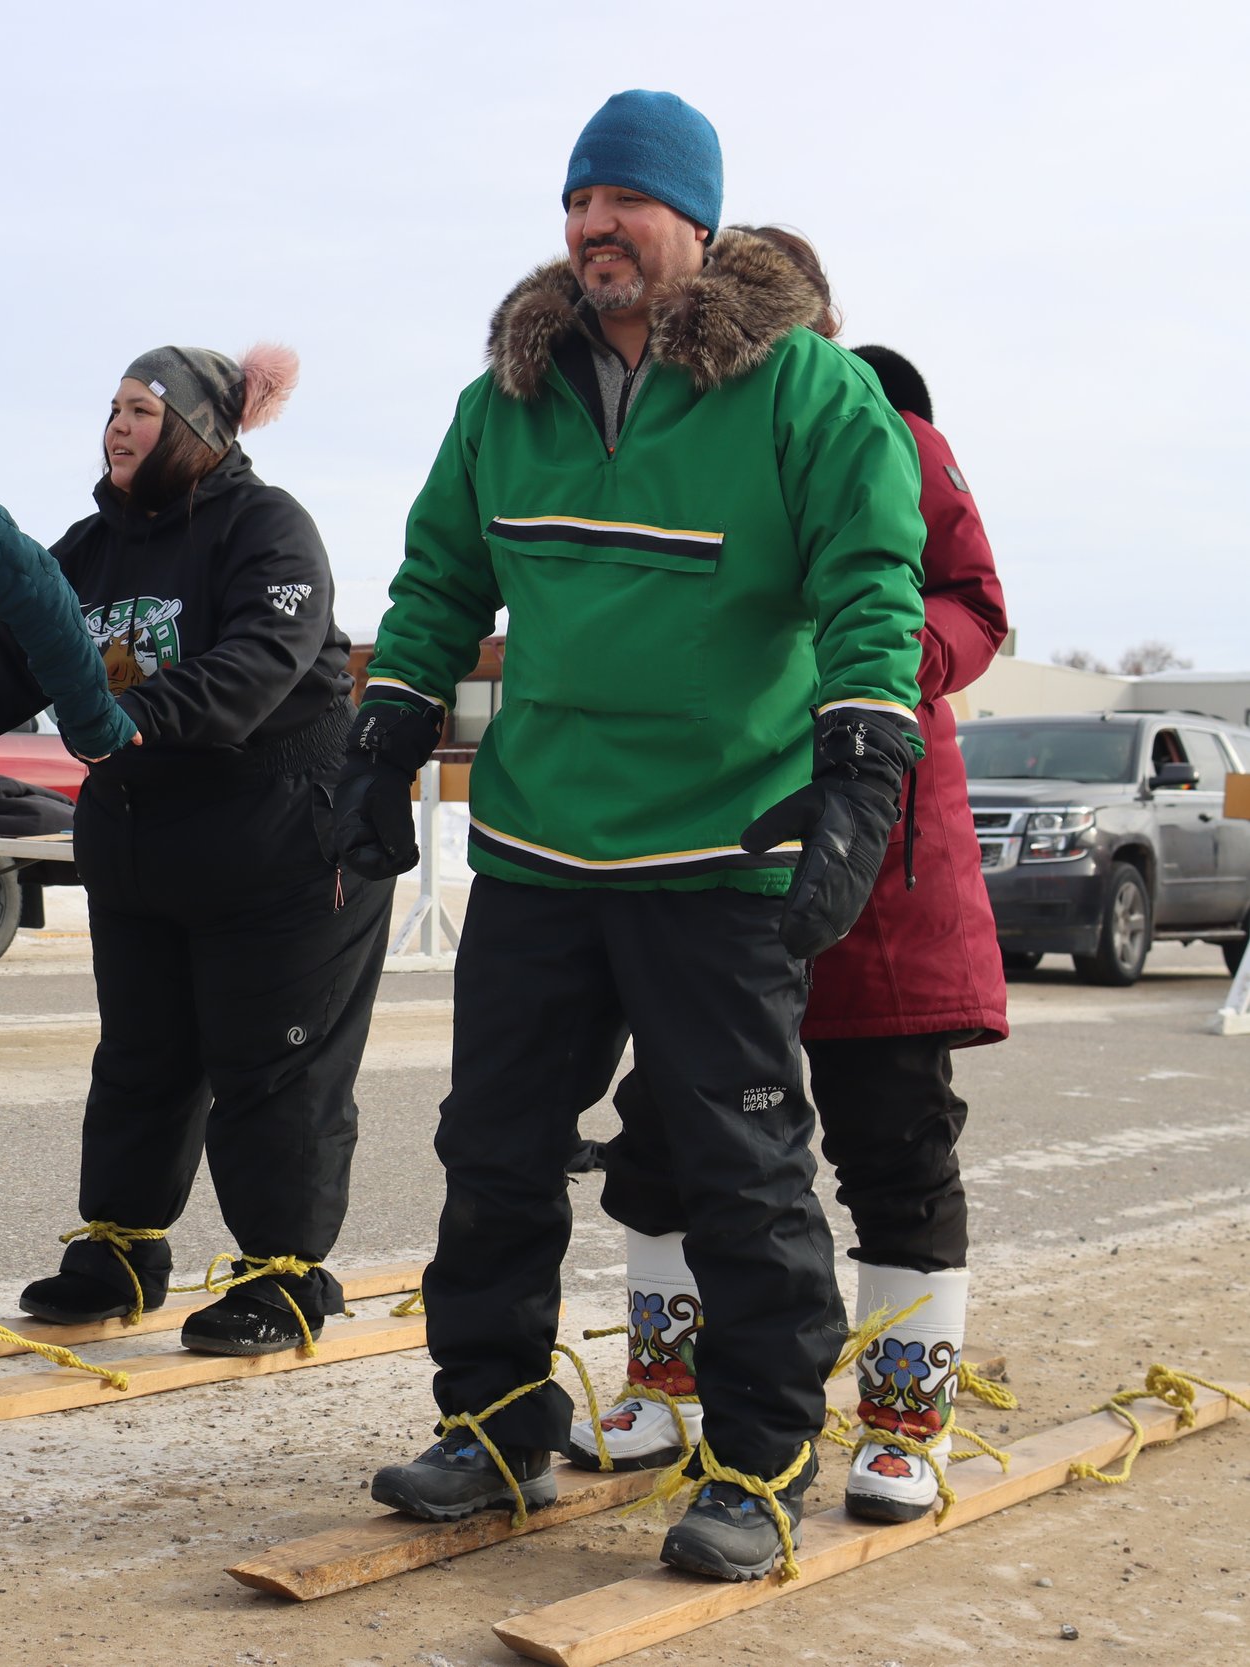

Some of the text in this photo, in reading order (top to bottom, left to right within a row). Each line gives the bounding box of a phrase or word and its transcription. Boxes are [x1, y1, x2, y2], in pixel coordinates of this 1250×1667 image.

[272, 591, 303, 617] 35
[743, 1086, 787, 1094] MOUNTAIN
[743, 1092, 768, 1104] HARD
[743, 1100, 768, 1112] WEAR
